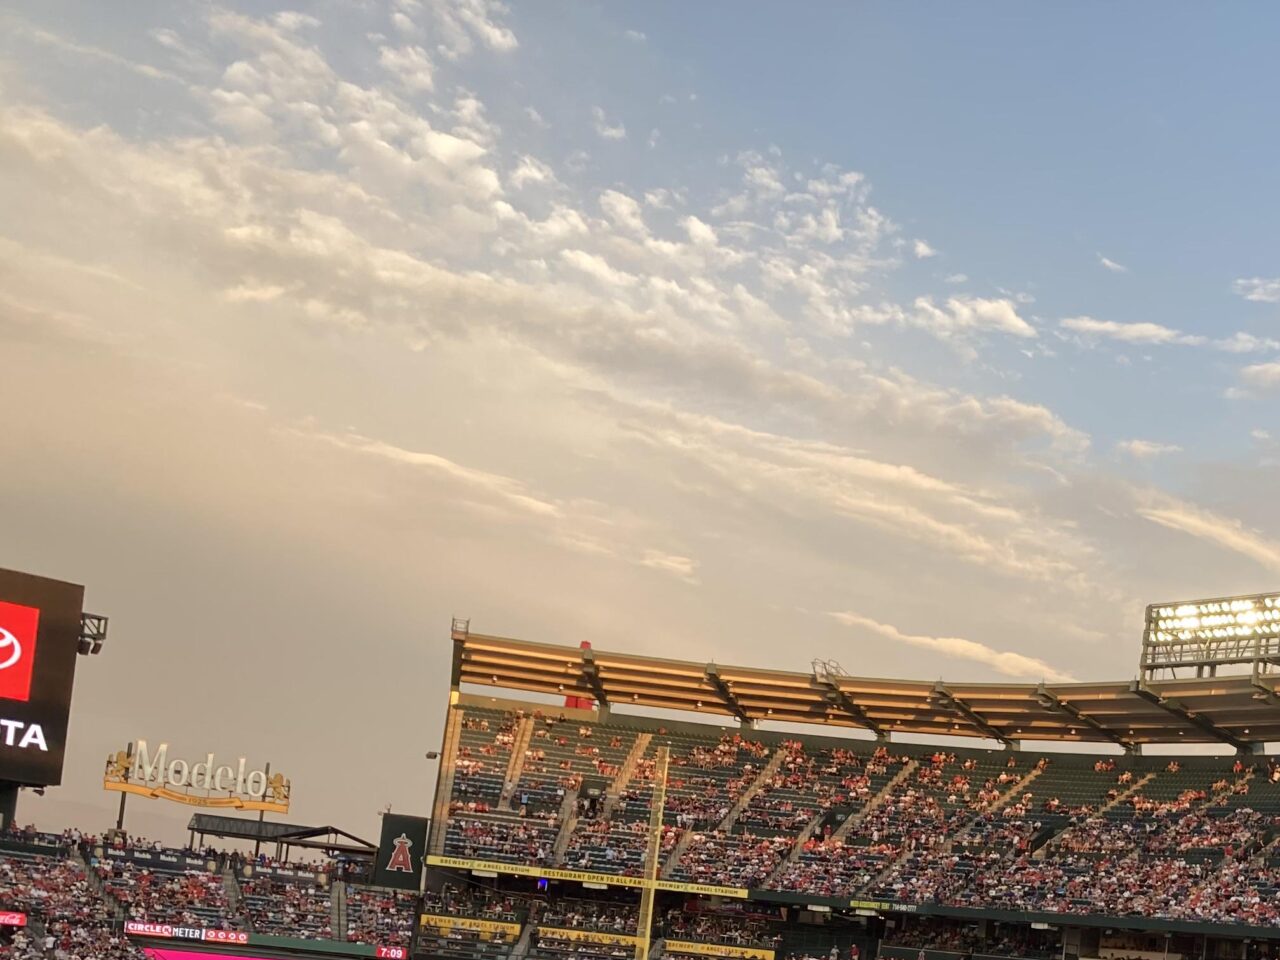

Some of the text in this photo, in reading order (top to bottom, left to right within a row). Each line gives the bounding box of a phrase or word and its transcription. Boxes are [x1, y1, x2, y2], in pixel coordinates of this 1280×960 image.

[134, 740, 267, 797] Modelo
[440, 858, 469, 867] BREWERY
[483, 863, 501, 871] ANGEL
[543, 870, 585, 881] RESTAURANT
[588, 874, 604, 882] OPEN
[658, 882, 683, 890] BREWERY
[714, 887, 738, 895] STADIUM
[128, 923, 161, 933] CIRCLE
[172, 927, 200, 938] METER
[380, 947, 403, 958] 7:09
